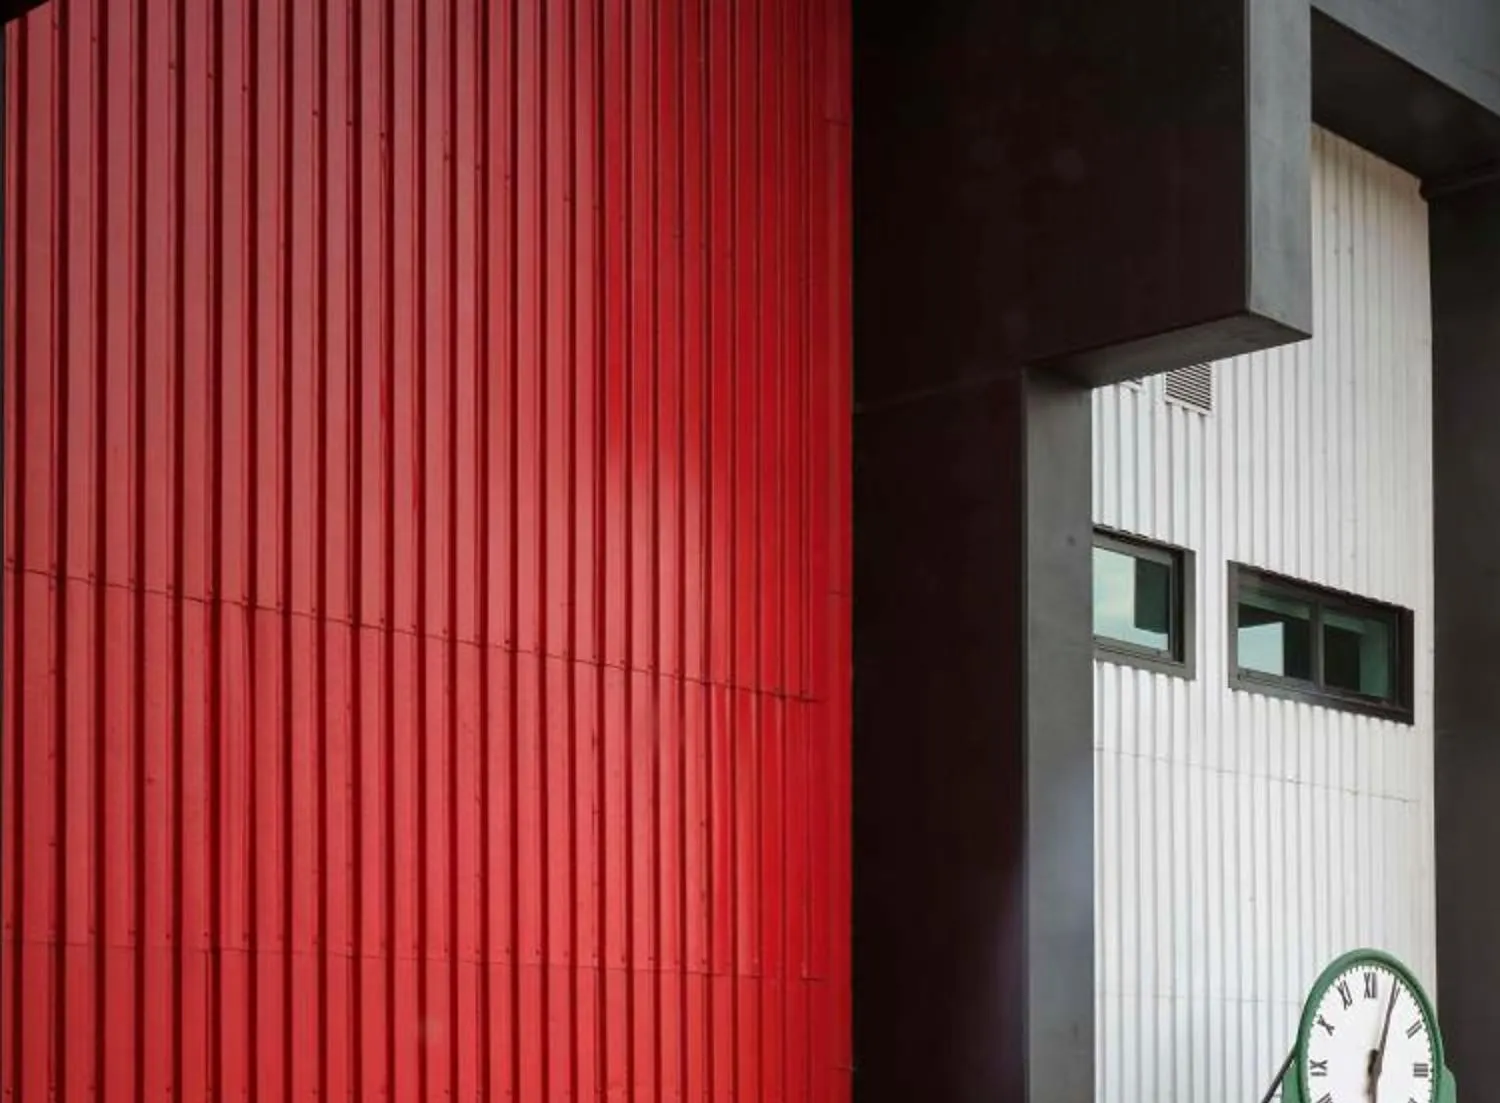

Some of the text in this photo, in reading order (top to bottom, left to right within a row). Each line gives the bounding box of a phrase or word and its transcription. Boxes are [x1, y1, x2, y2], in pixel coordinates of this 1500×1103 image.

[1337, 980, 1353, 1010] XI
[1364, 972, 1377, 999] XII
[1317, 1015, 1335, 1036] X
[1406, 1020, 1422, 1039] II
[1309, 1060, 1328, 1077] IX
[1413, 1063, 1429, 1077] III
